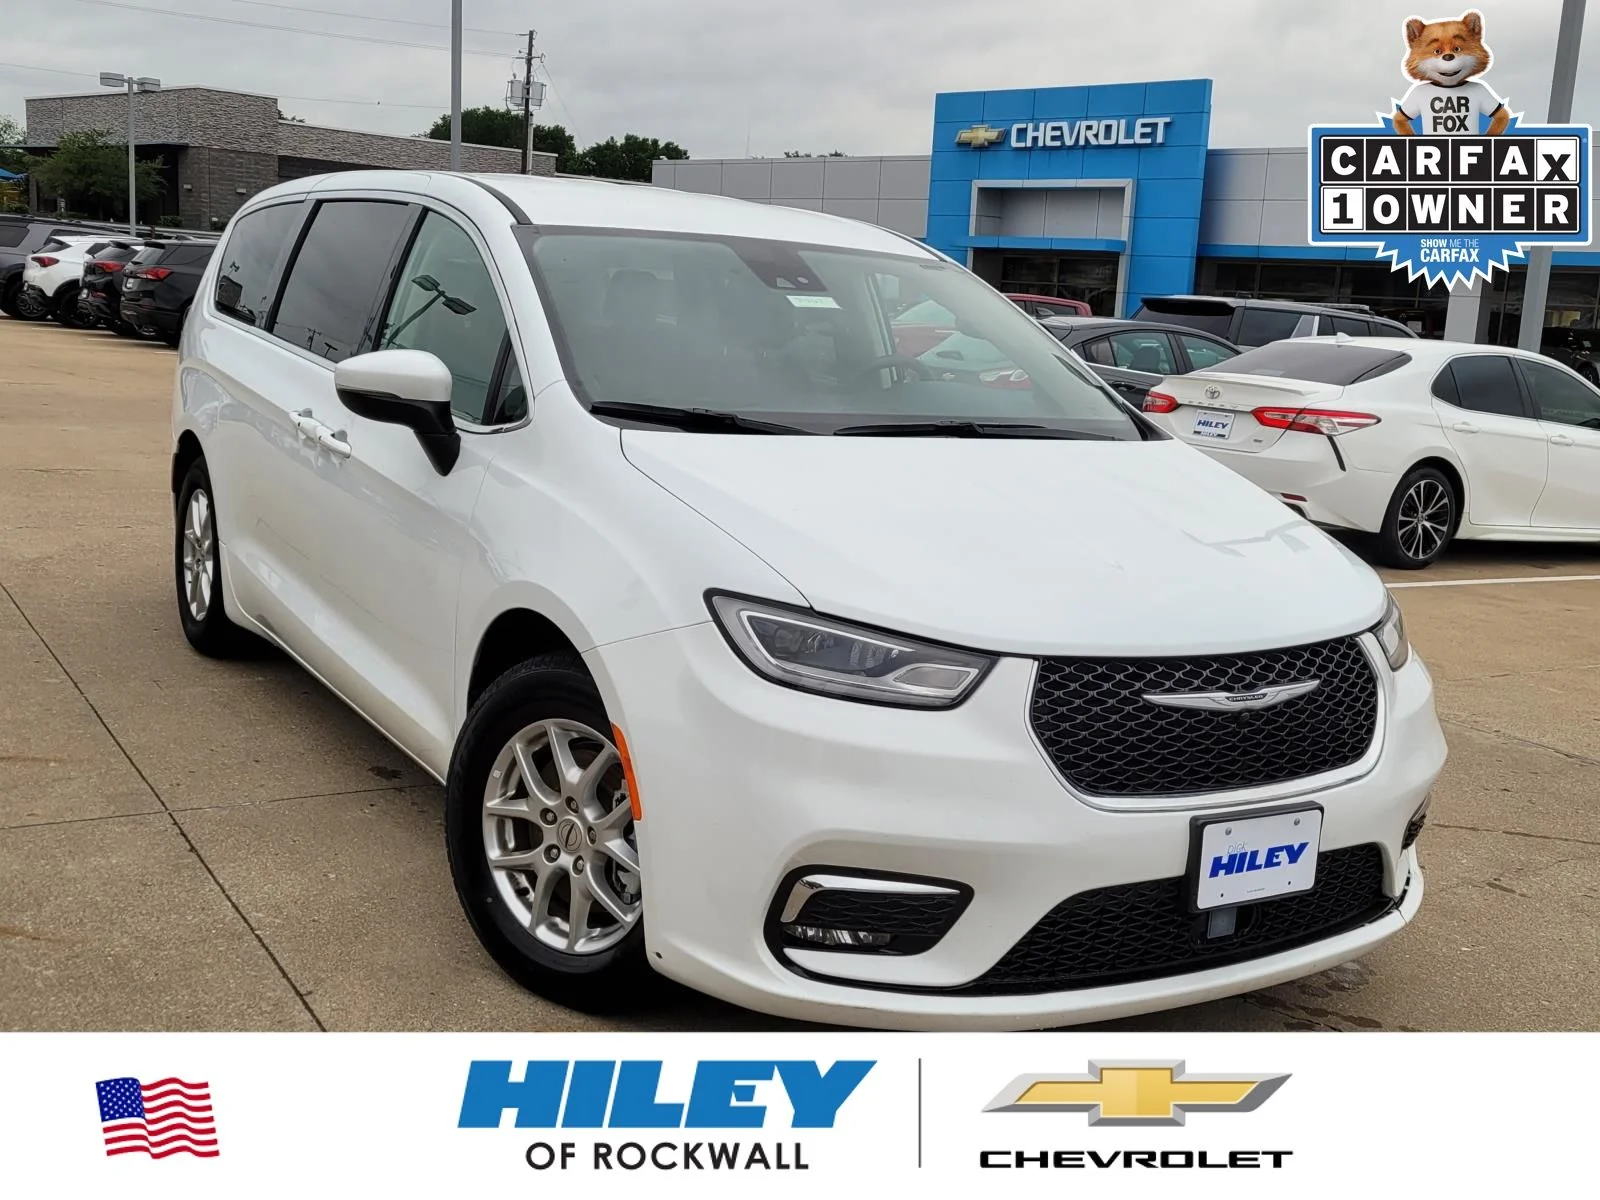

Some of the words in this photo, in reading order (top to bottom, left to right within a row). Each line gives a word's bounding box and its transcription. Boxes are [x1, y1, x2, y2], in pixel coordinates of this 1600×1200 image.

[1010, 117, 1172, 148] CHEVROLET
[1197, 419, 1230, 430] HILEY
[1208, 841, 1310, 879] HILEY
